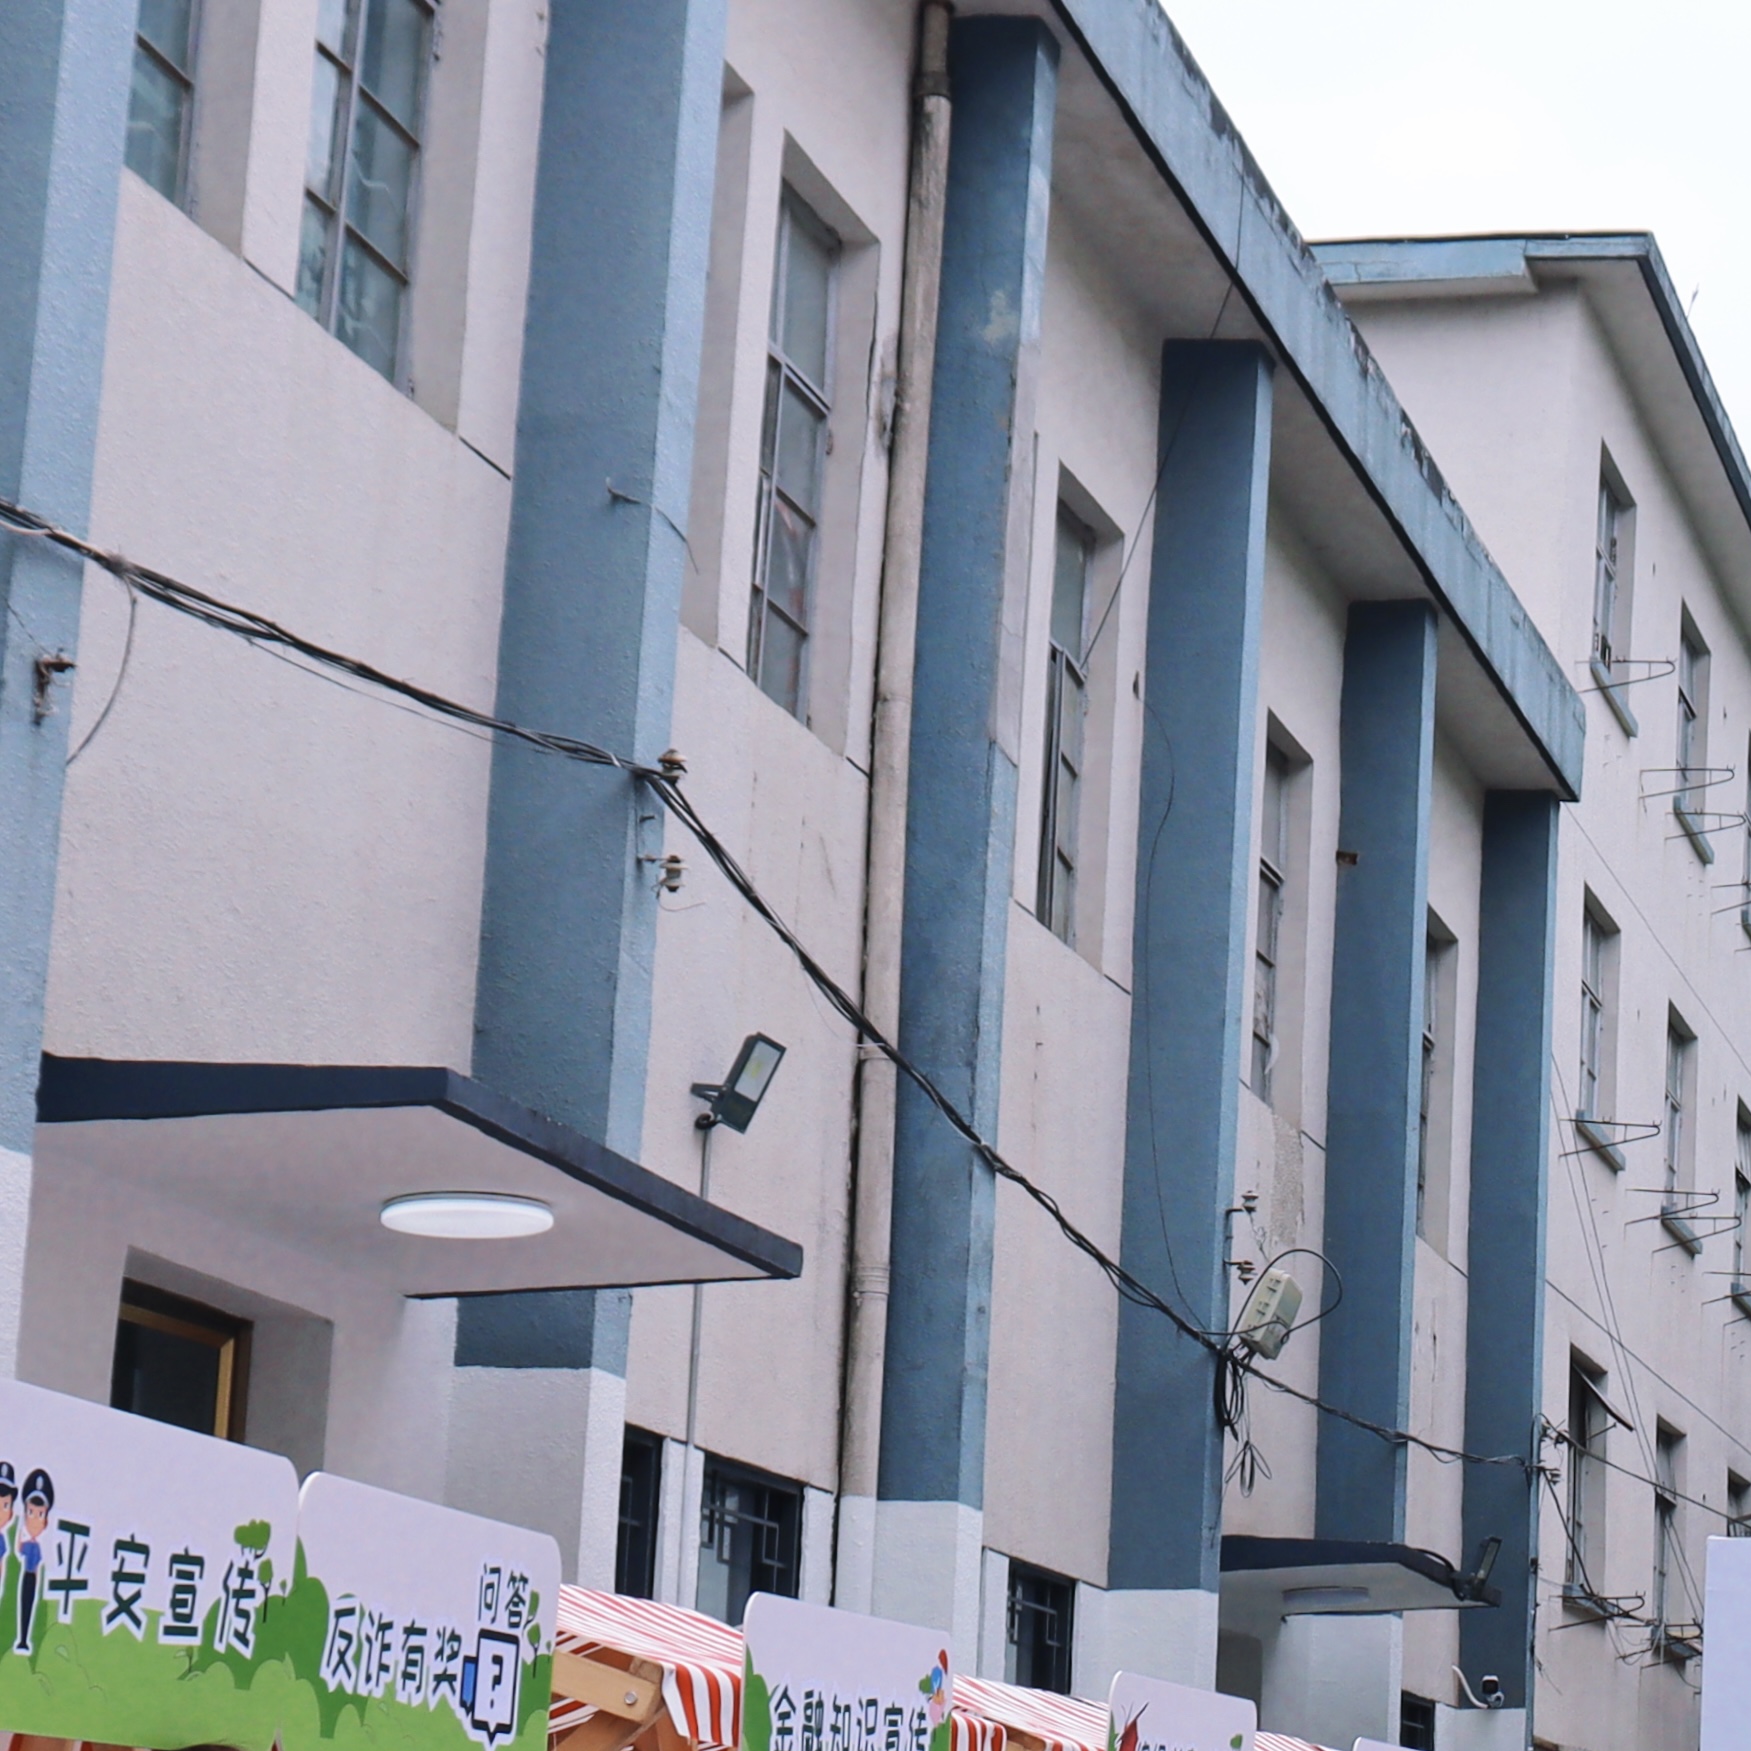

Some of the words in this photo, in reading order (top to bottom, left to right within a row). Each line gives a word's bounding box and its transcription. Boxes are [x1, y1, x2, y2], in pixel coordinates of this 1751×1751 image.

[47, 1518, 257, 1650] 平安宣传
[477, 1562, 530, 1629] 问答
[326, 1606, 463, 1696] 反诈有奖
